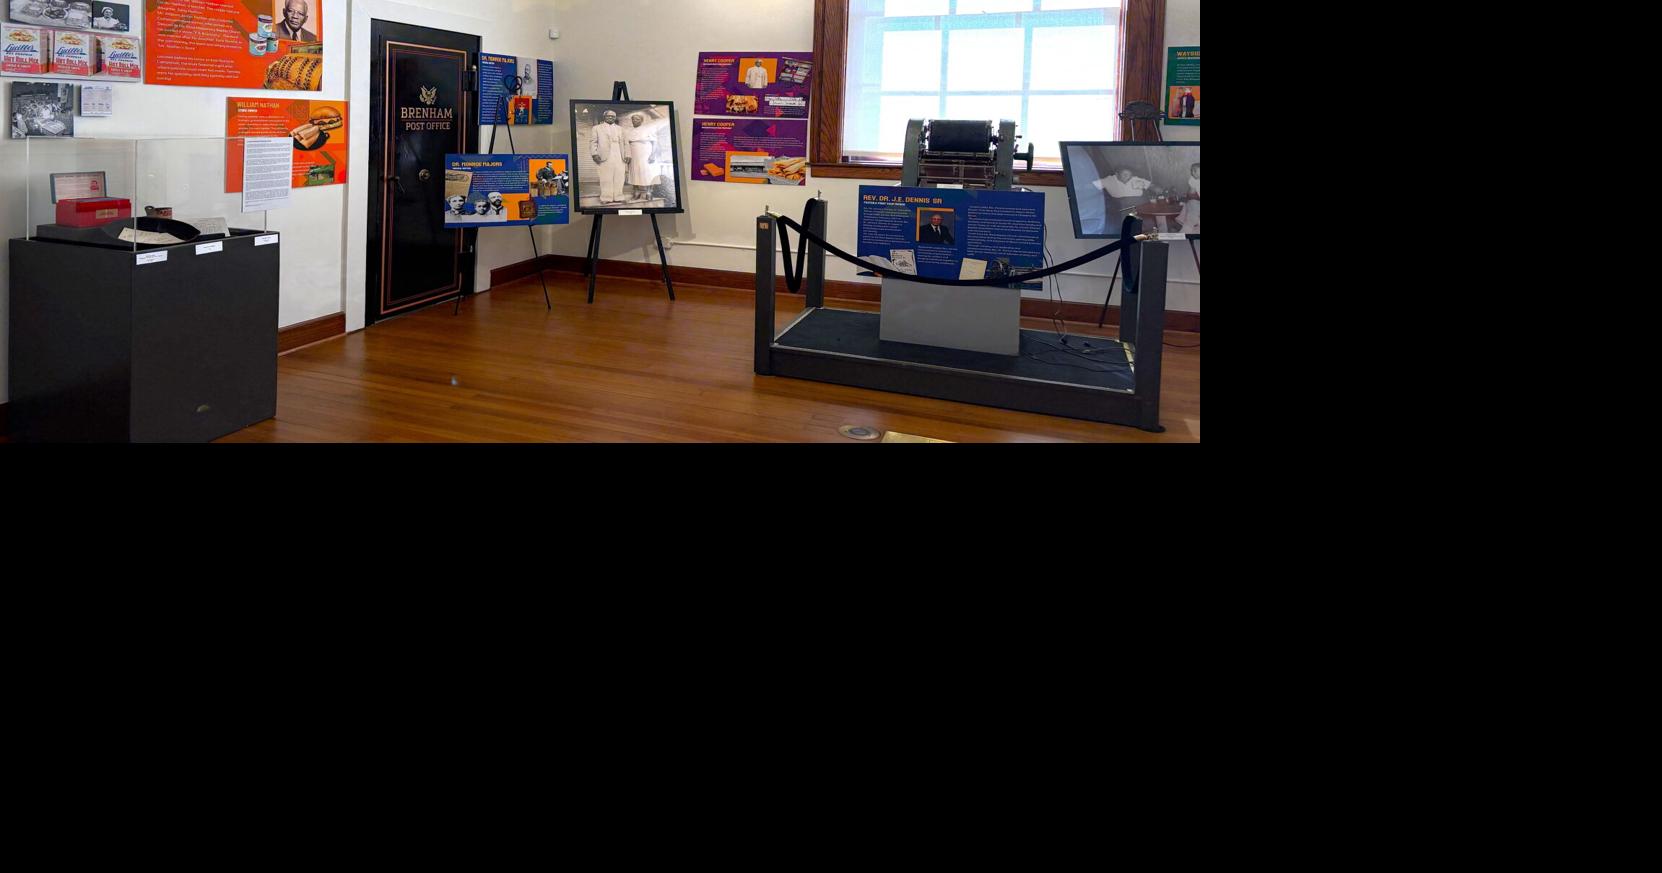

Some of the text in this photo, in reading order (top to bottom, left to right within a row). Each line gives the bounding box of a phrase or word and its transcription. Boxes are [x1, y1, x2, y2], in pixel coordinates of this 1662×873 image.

[400, 107, 452, 118] BRENHAM
[406, 122, 450, 130] POST OFFICE
